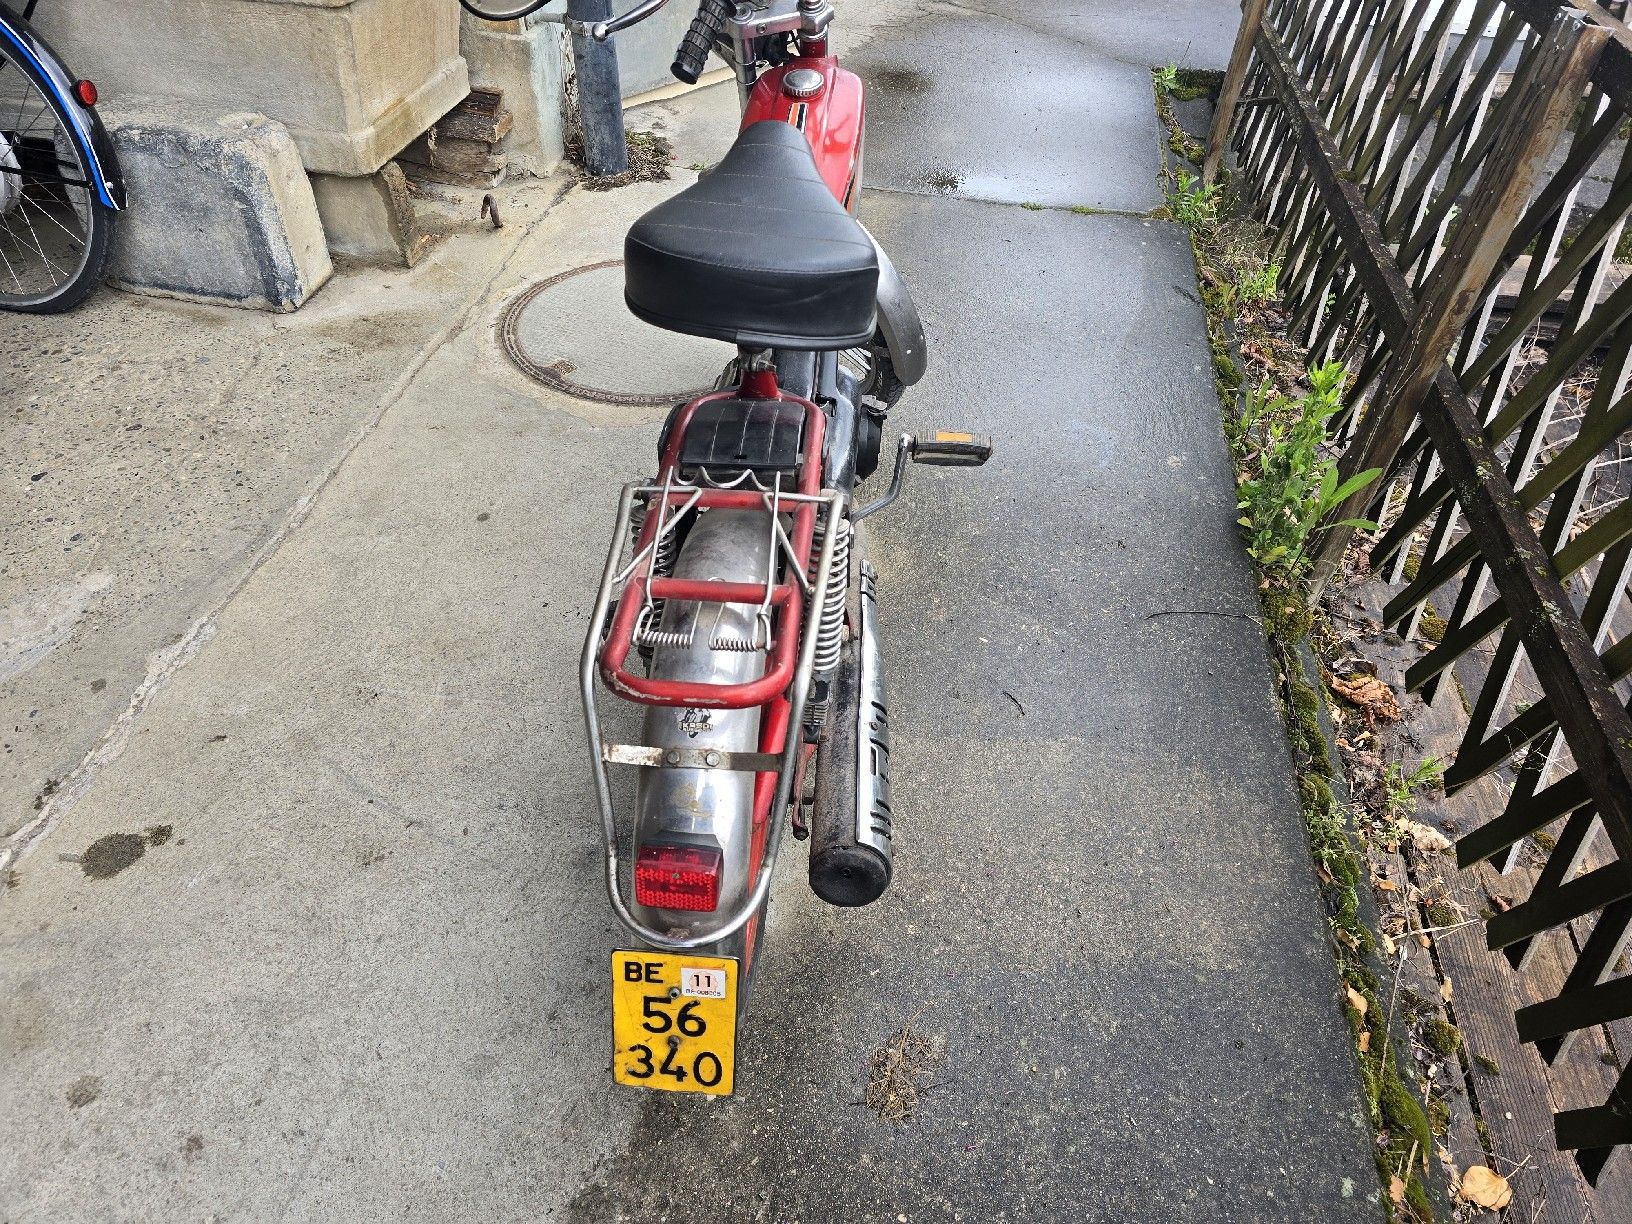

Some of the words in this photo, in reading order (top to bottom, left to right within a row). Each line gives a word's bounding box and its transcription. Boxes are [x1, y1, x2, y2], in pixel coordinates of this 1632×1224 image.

[624, 961, 664, 984] BE
[693, 974, 711, 987] 11
[642, 995, 707, 1037] 56
[626, 1044, 723, 1087] 340
